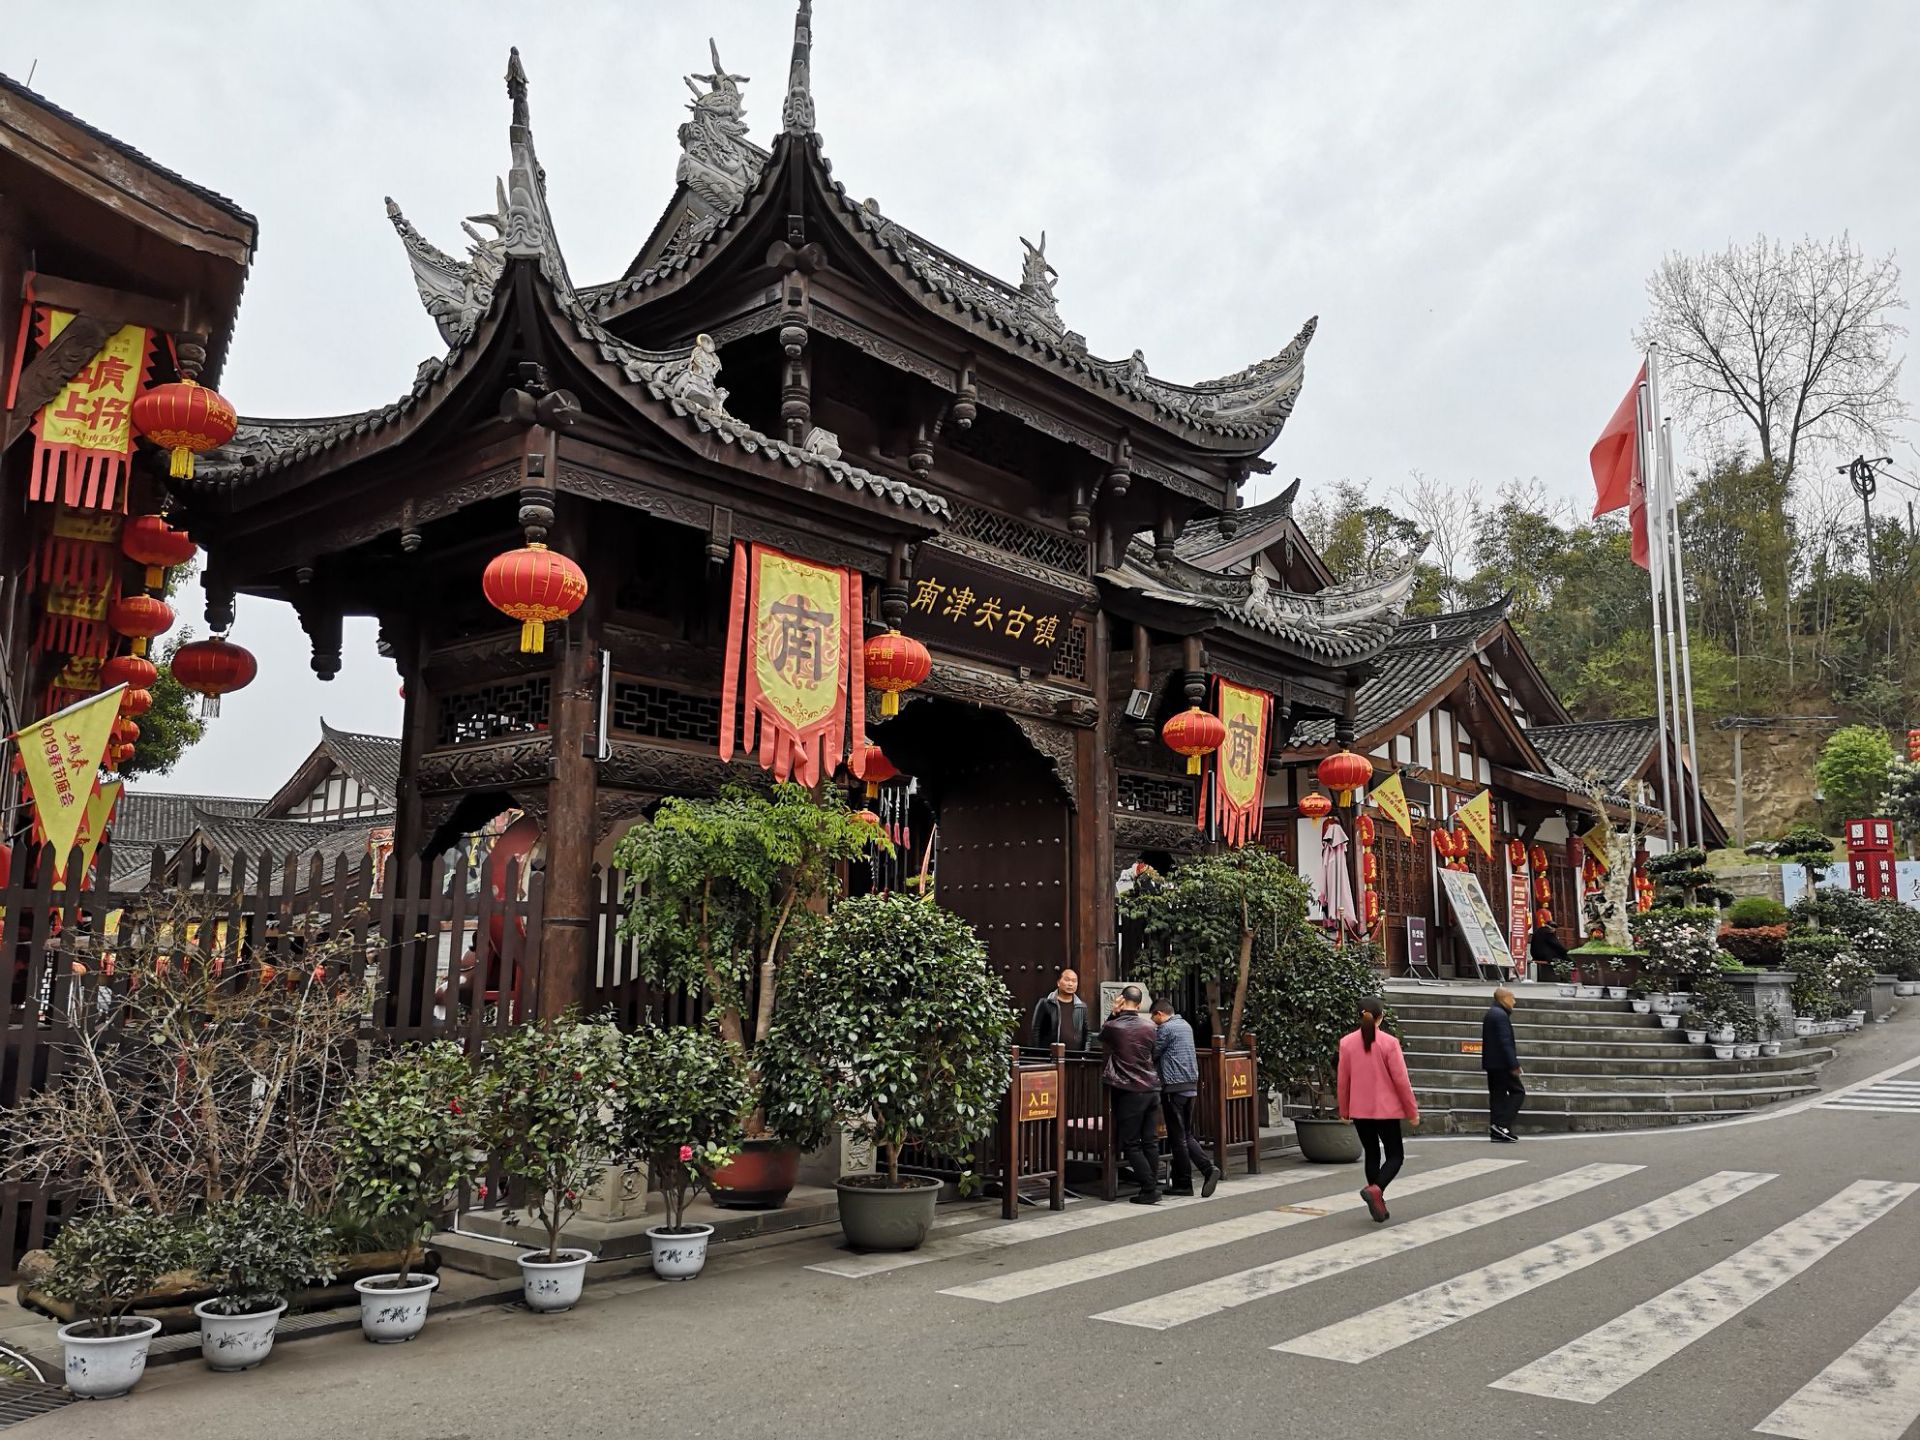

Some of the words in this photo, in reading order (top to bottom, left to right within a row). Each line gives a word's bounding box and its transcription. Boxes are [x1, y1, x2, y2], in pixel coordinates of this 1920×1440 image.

[54, 391, 130, 433] 上将
[771, 594, 834, 681] 南
[911, 577, 1060, 648] 南津关古镇
[865, 647, 895, 660] 宁醋
[40, 721, 75, 807] 2019春节庙会
[1229, 713, 1258, 776] 南
[1028, 1092, 1049, 1107] 入口
[1232, 1074, 1247, 1087] 入口
